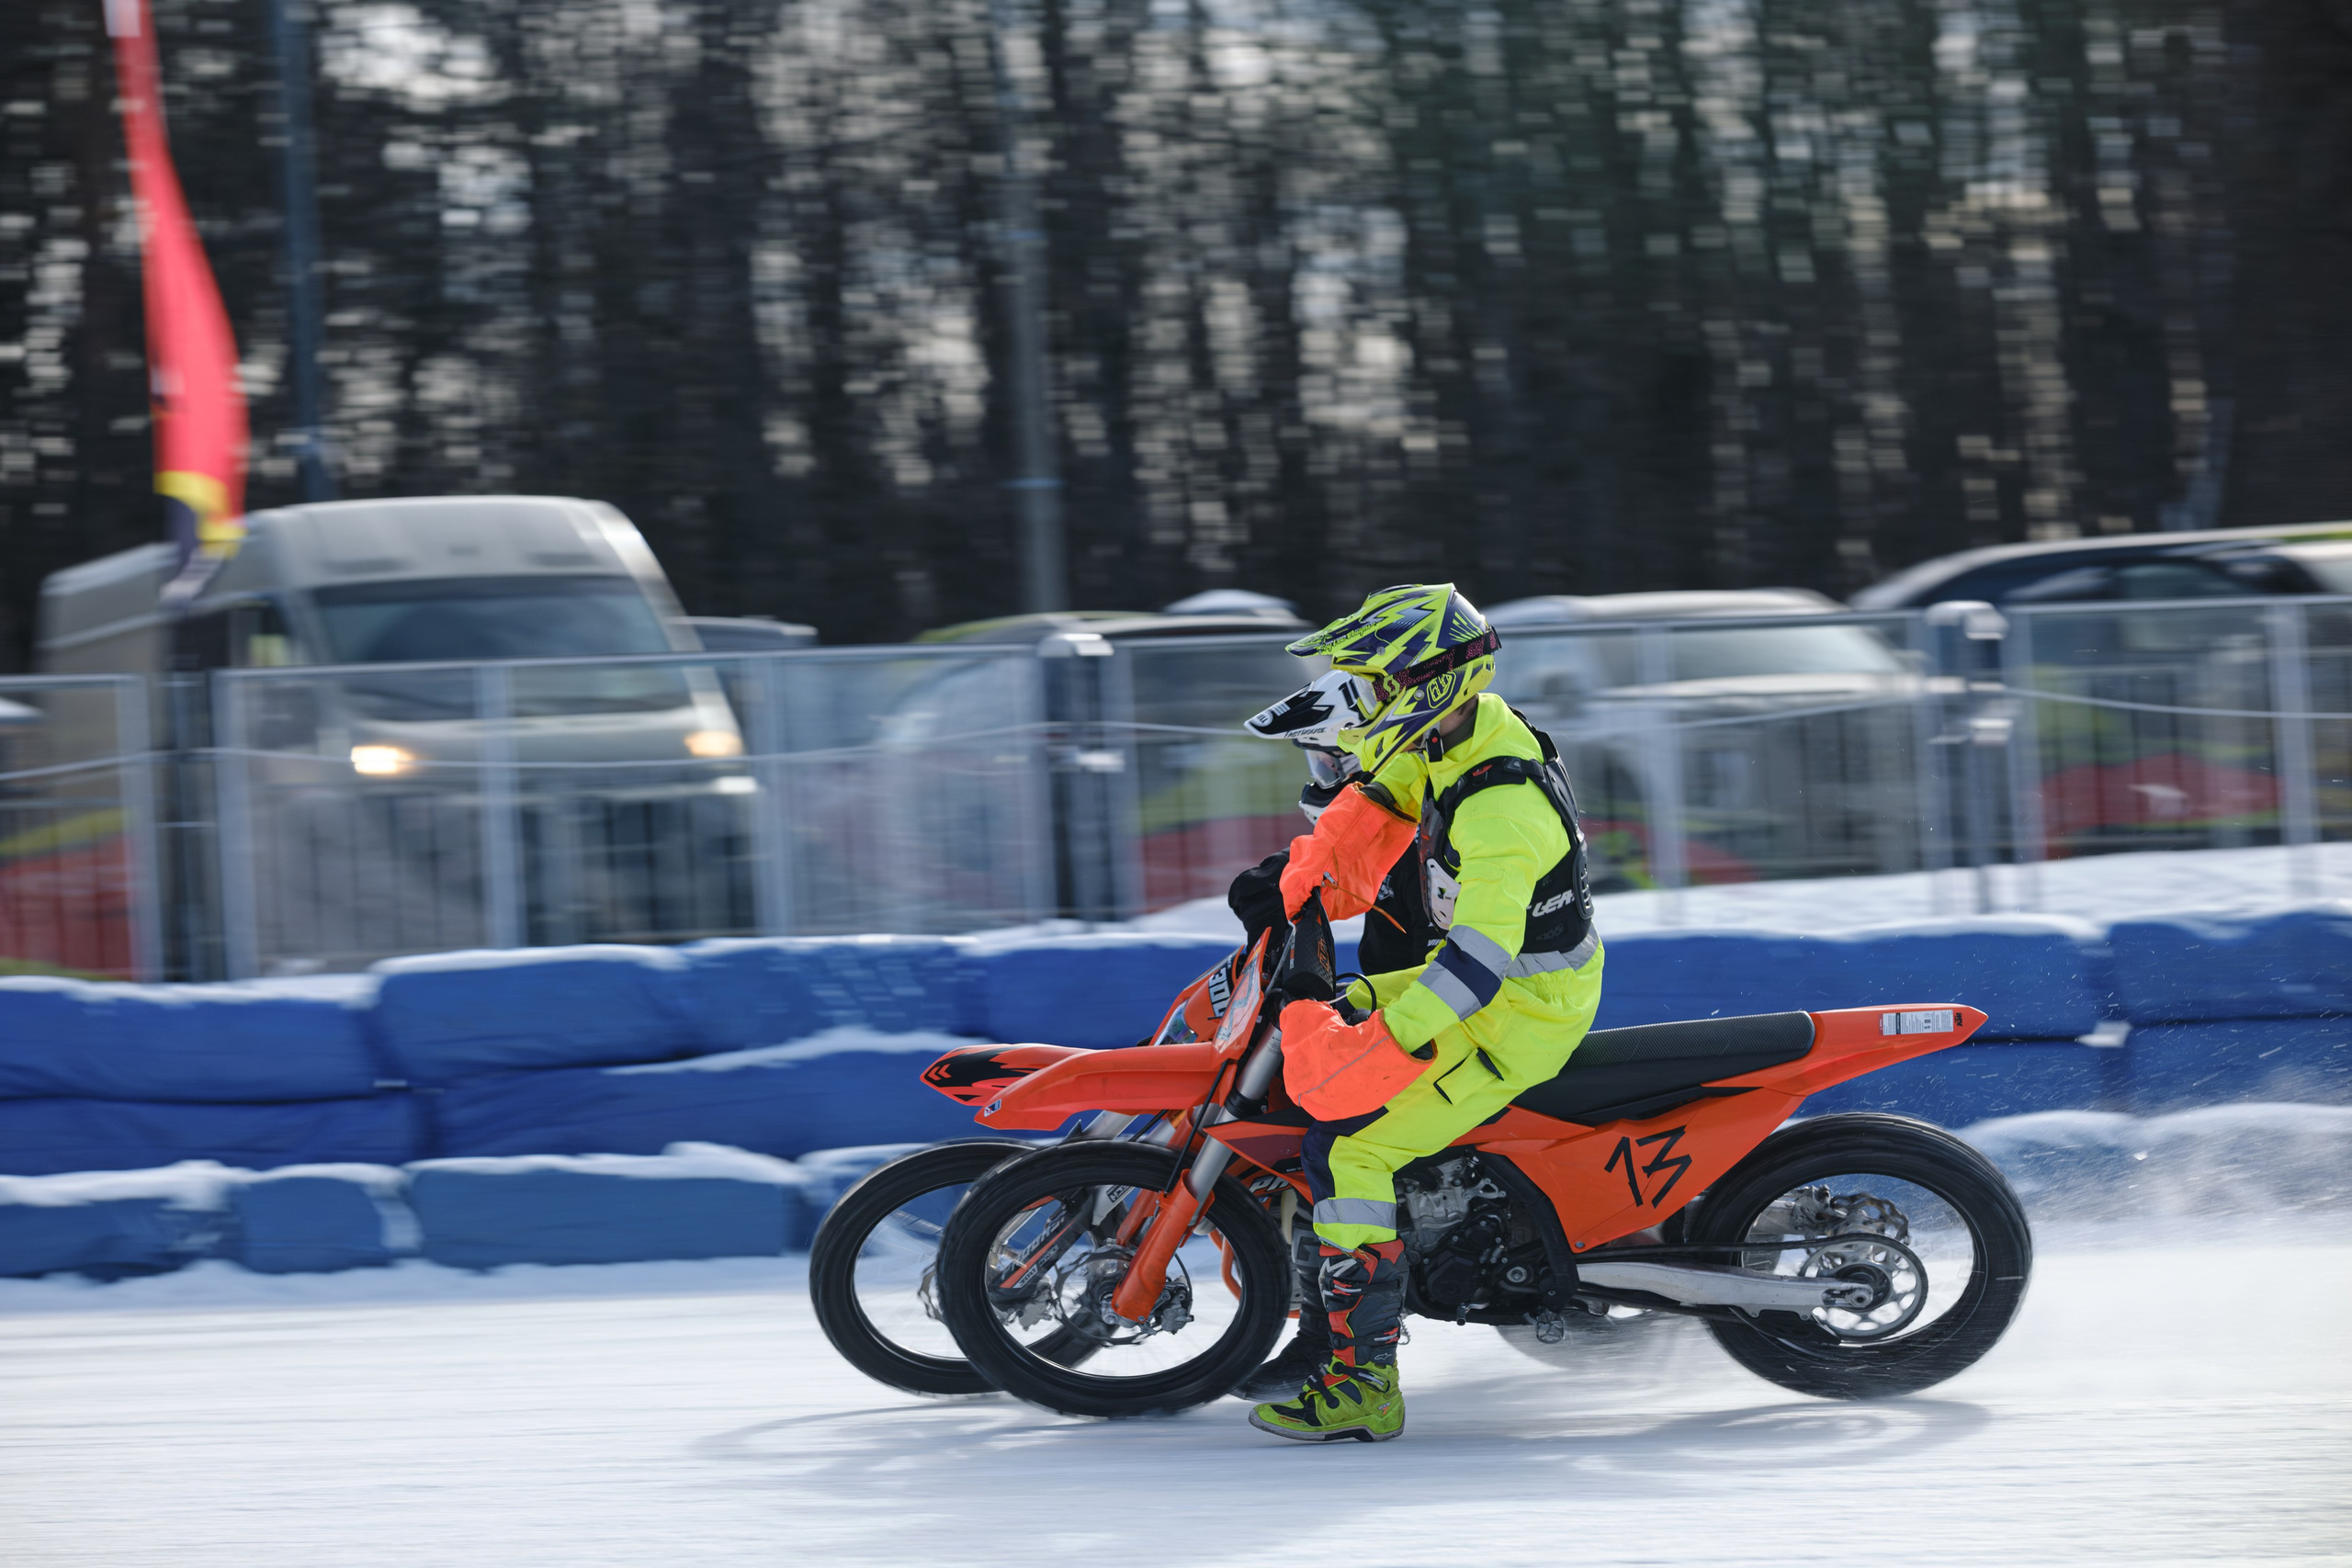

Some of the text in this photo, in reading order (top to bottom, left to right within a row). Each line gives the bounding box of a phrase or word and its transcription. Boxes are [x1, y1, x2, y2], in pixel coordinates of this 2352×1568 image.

[1283, 727, 1327, 738] FASTHOUSE
[1532, 888, 1576, 918] LEA
[1954, 1012, 1963, 1027] KTM
[1603, 1123, 1693, 1210] 13
